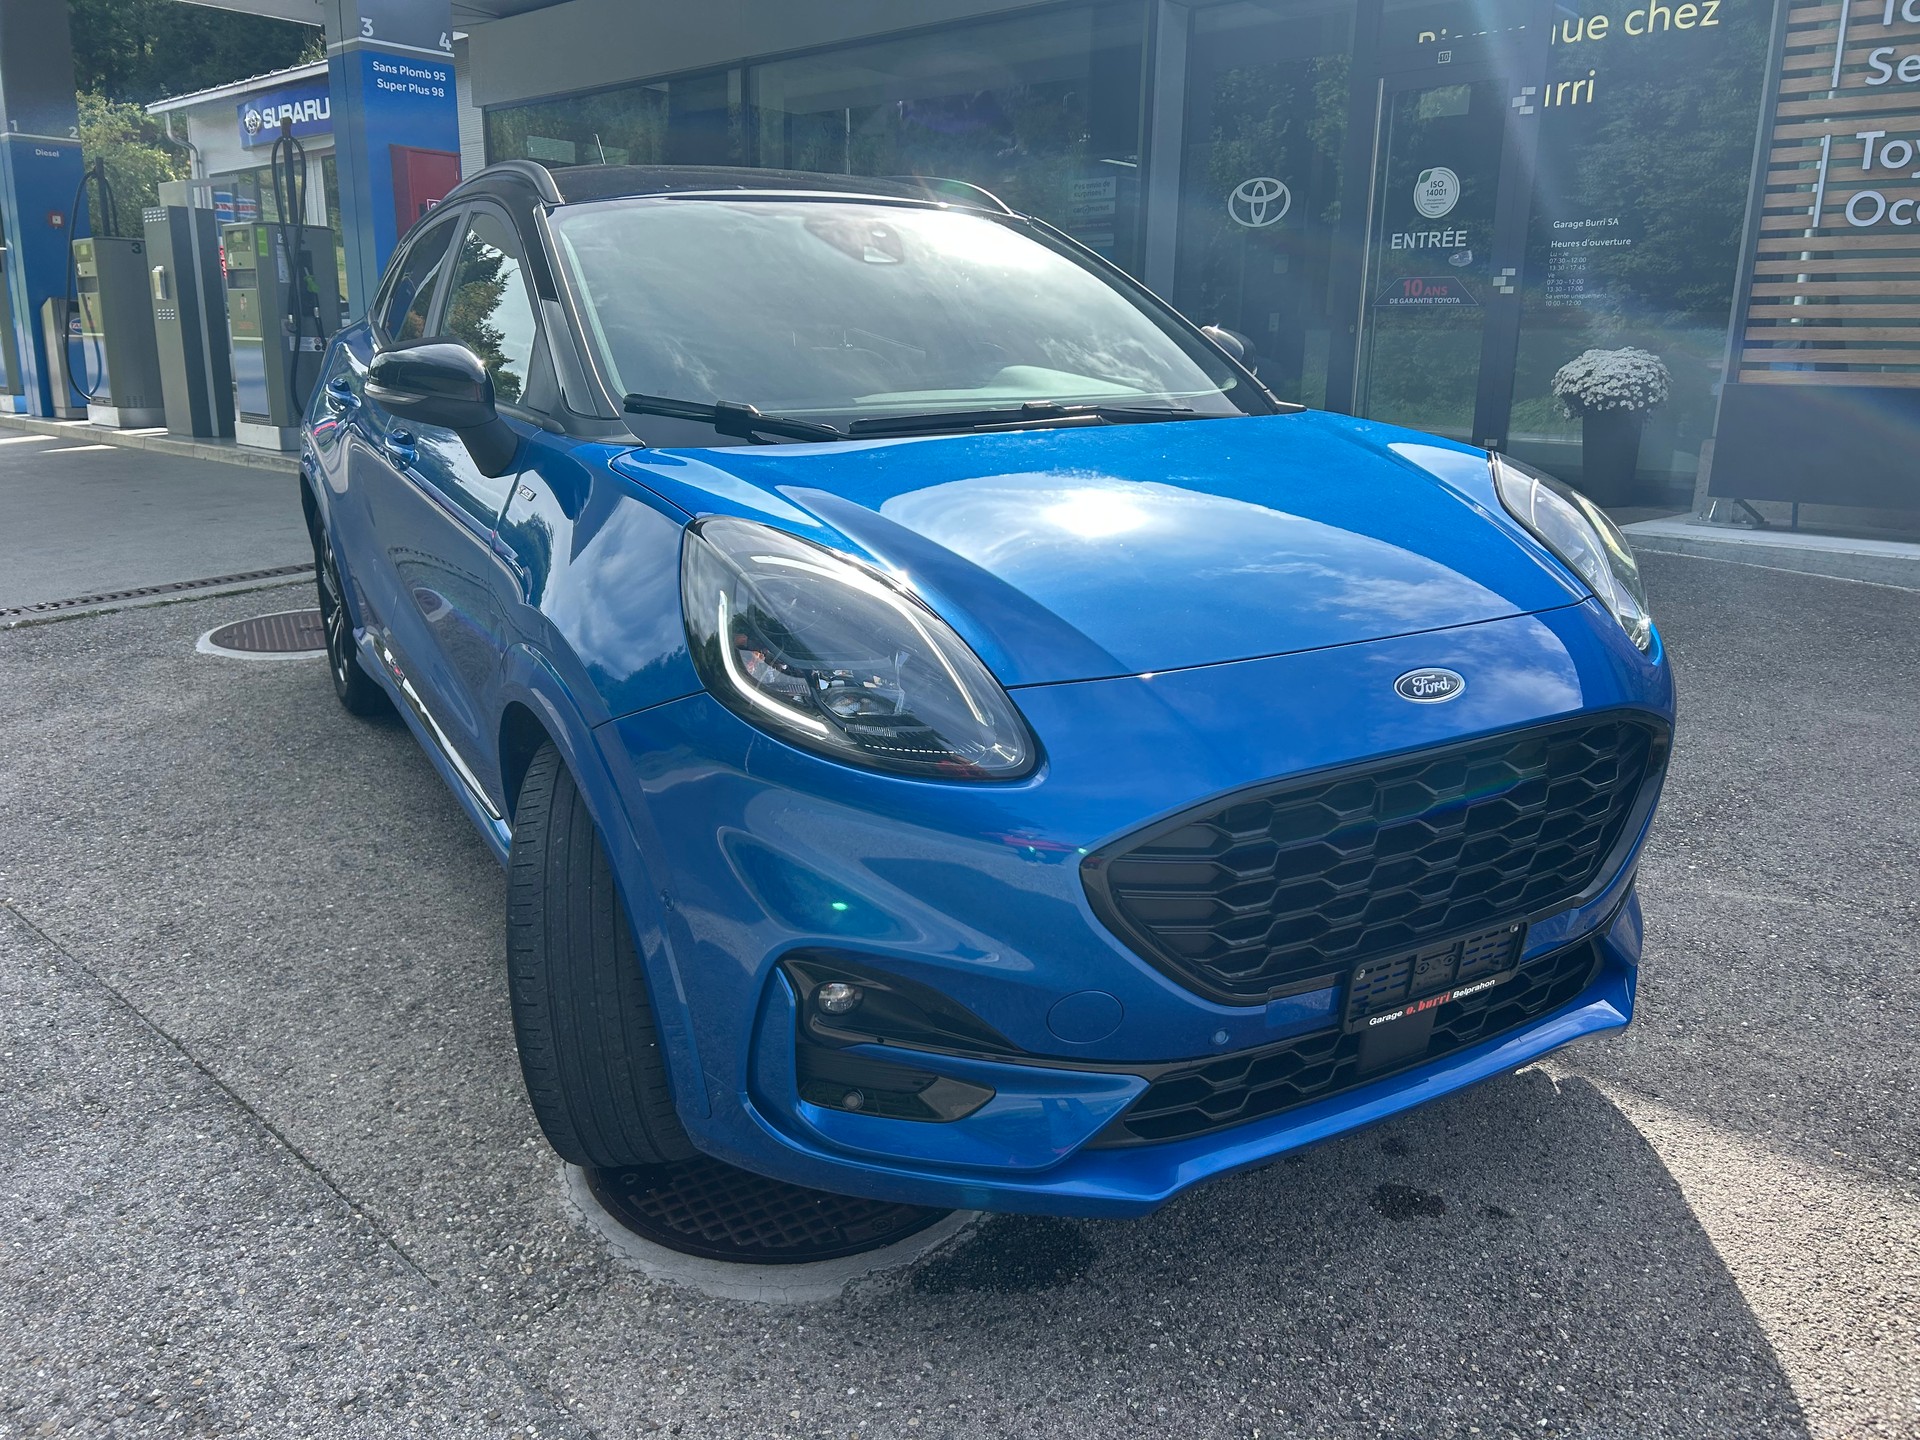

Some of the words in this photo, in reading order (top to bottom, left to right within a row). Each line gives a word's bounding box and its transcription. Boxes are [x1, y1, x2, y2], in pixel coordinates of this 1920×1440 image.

[1624, 0, 1721, 36] chez
[360, 16, 374, 37] 3
[438, 31, 452, 51] 4
[372, 60, 398, 74] Sans
[399, 65, 432, 80] Plomb
[433, 71, 446, 82] 95
[376, 78, 407, 92] Super
[408, 83, 430, 96] Plus
[431, 87, 445, 98] 98
[262, 96, 332, 130] SUBARU
[10, 119, 18, 132] 1
[68, 126, 79, 139] 2
[35, 148, 60, 158] Diesel
[1855, 130, 1920, 179] To
[1426, 188, 1447, 197] 14001
[1430, 180, 1445, 188] ISO
[1845, 190, 1920, 227] Oc
[1553, 220, 1584, 230] Garage
[1585, 218, 1606, 227] Burri
[1607, 217, 1619, 226] SA
[131, 242, 143, 255] 3
[1391, 226, 1468, 250] ENTRÉE
[1551, 240, 1580, 249] Heures
[1581, 238, 1632, 247] d'ouverture
[1403, 279, 1423, 297] 10
[1423, 286, 1448, 296] ANS
[1412, 674, 1451, 696] Ford
[1369, 1009, 1404, 1026] Garage
[1418, 991, 1450, 1009] burri
[1453, 979, 1496, 999] Belprahon
